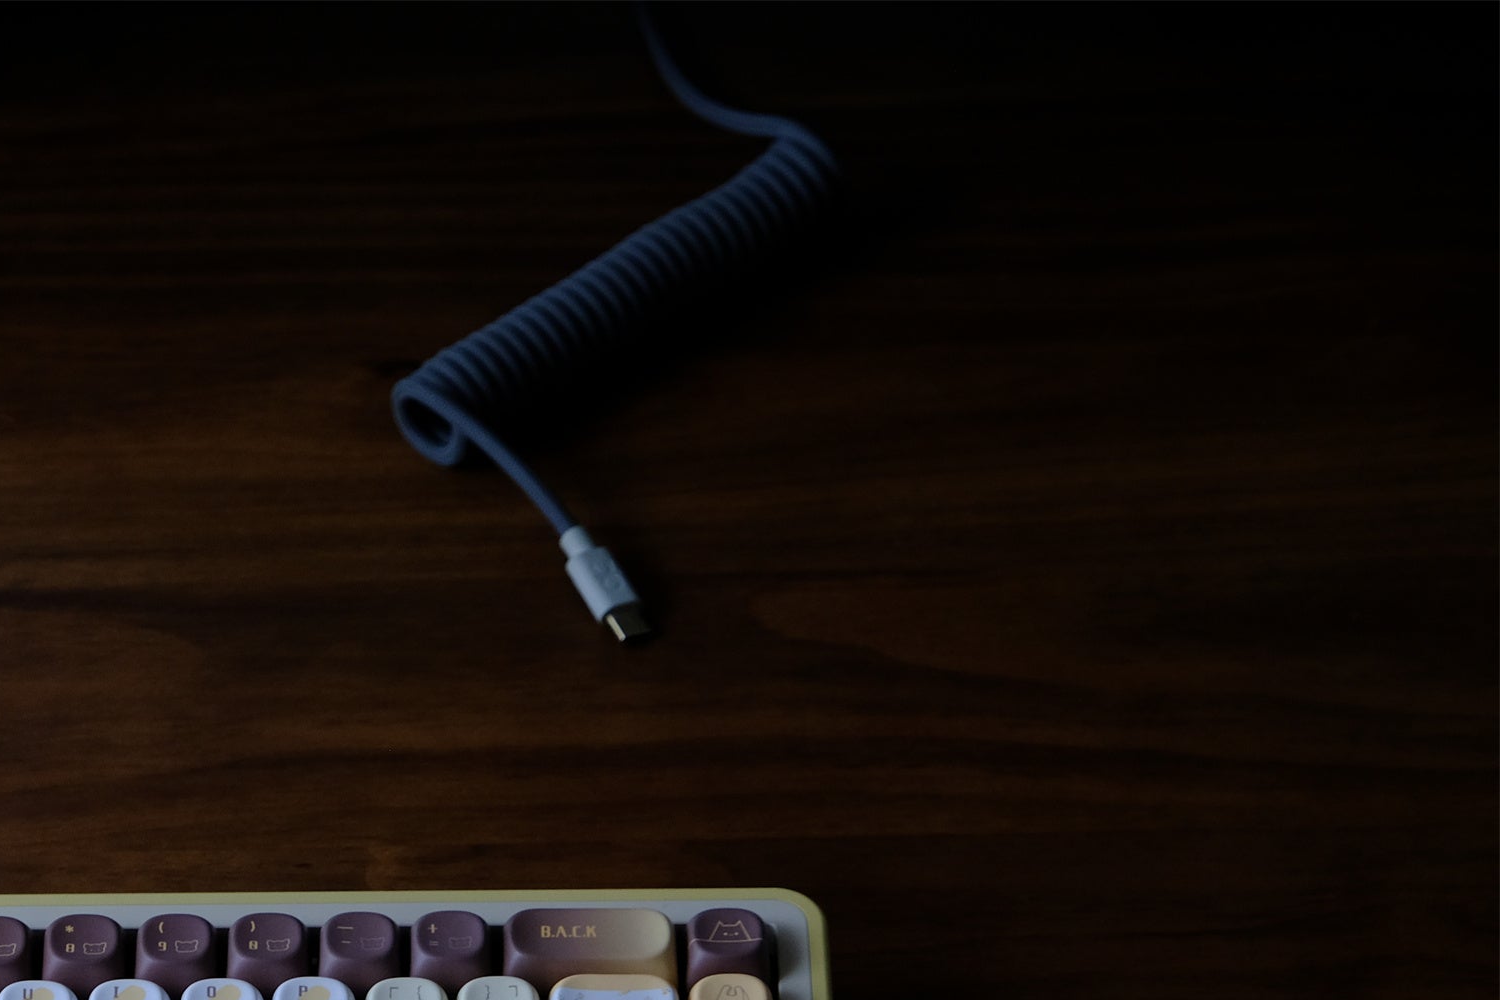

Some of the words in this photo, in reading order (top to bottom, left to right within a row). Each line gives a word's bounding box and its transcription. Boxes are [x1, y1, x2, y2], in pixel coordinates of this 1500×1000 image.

[540, 925, 597, 938] B.A.C.K
[66, 943, 75, 953] 8
[158, 941, 167, 951] 9
[249, 941, 258, 950] 0
[23, 989, 33, 1000] U
[113, 987, 119, 998] I
[299, 986, 308, 997] P
